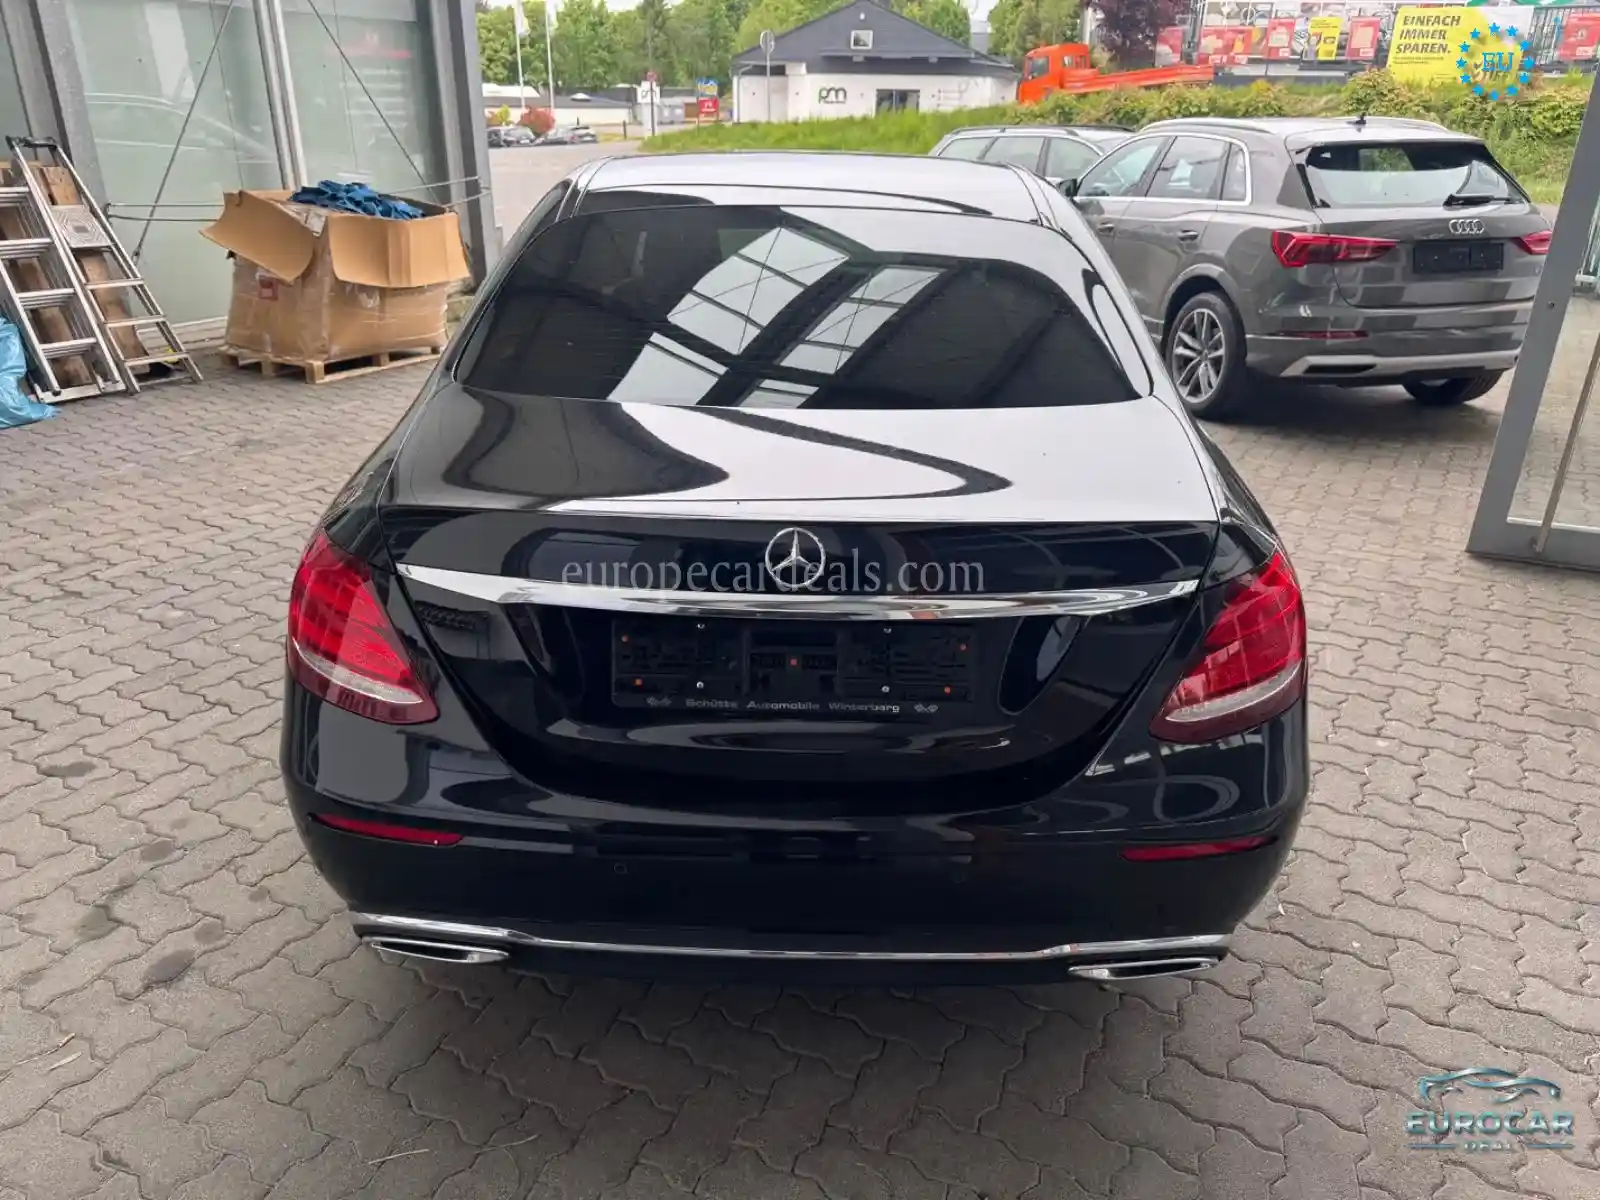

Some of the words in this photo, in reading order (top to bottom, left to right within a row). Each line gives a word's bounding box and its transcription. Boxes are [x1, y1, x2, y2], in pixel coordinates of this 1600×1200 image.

[1403, 15, 1461, 27] EINFACH
[1399, 28, 1447, 41] IMMER
[1396, 42, 1451, 55] SPAREN.
[746, 700, 820, 711] Automobile
